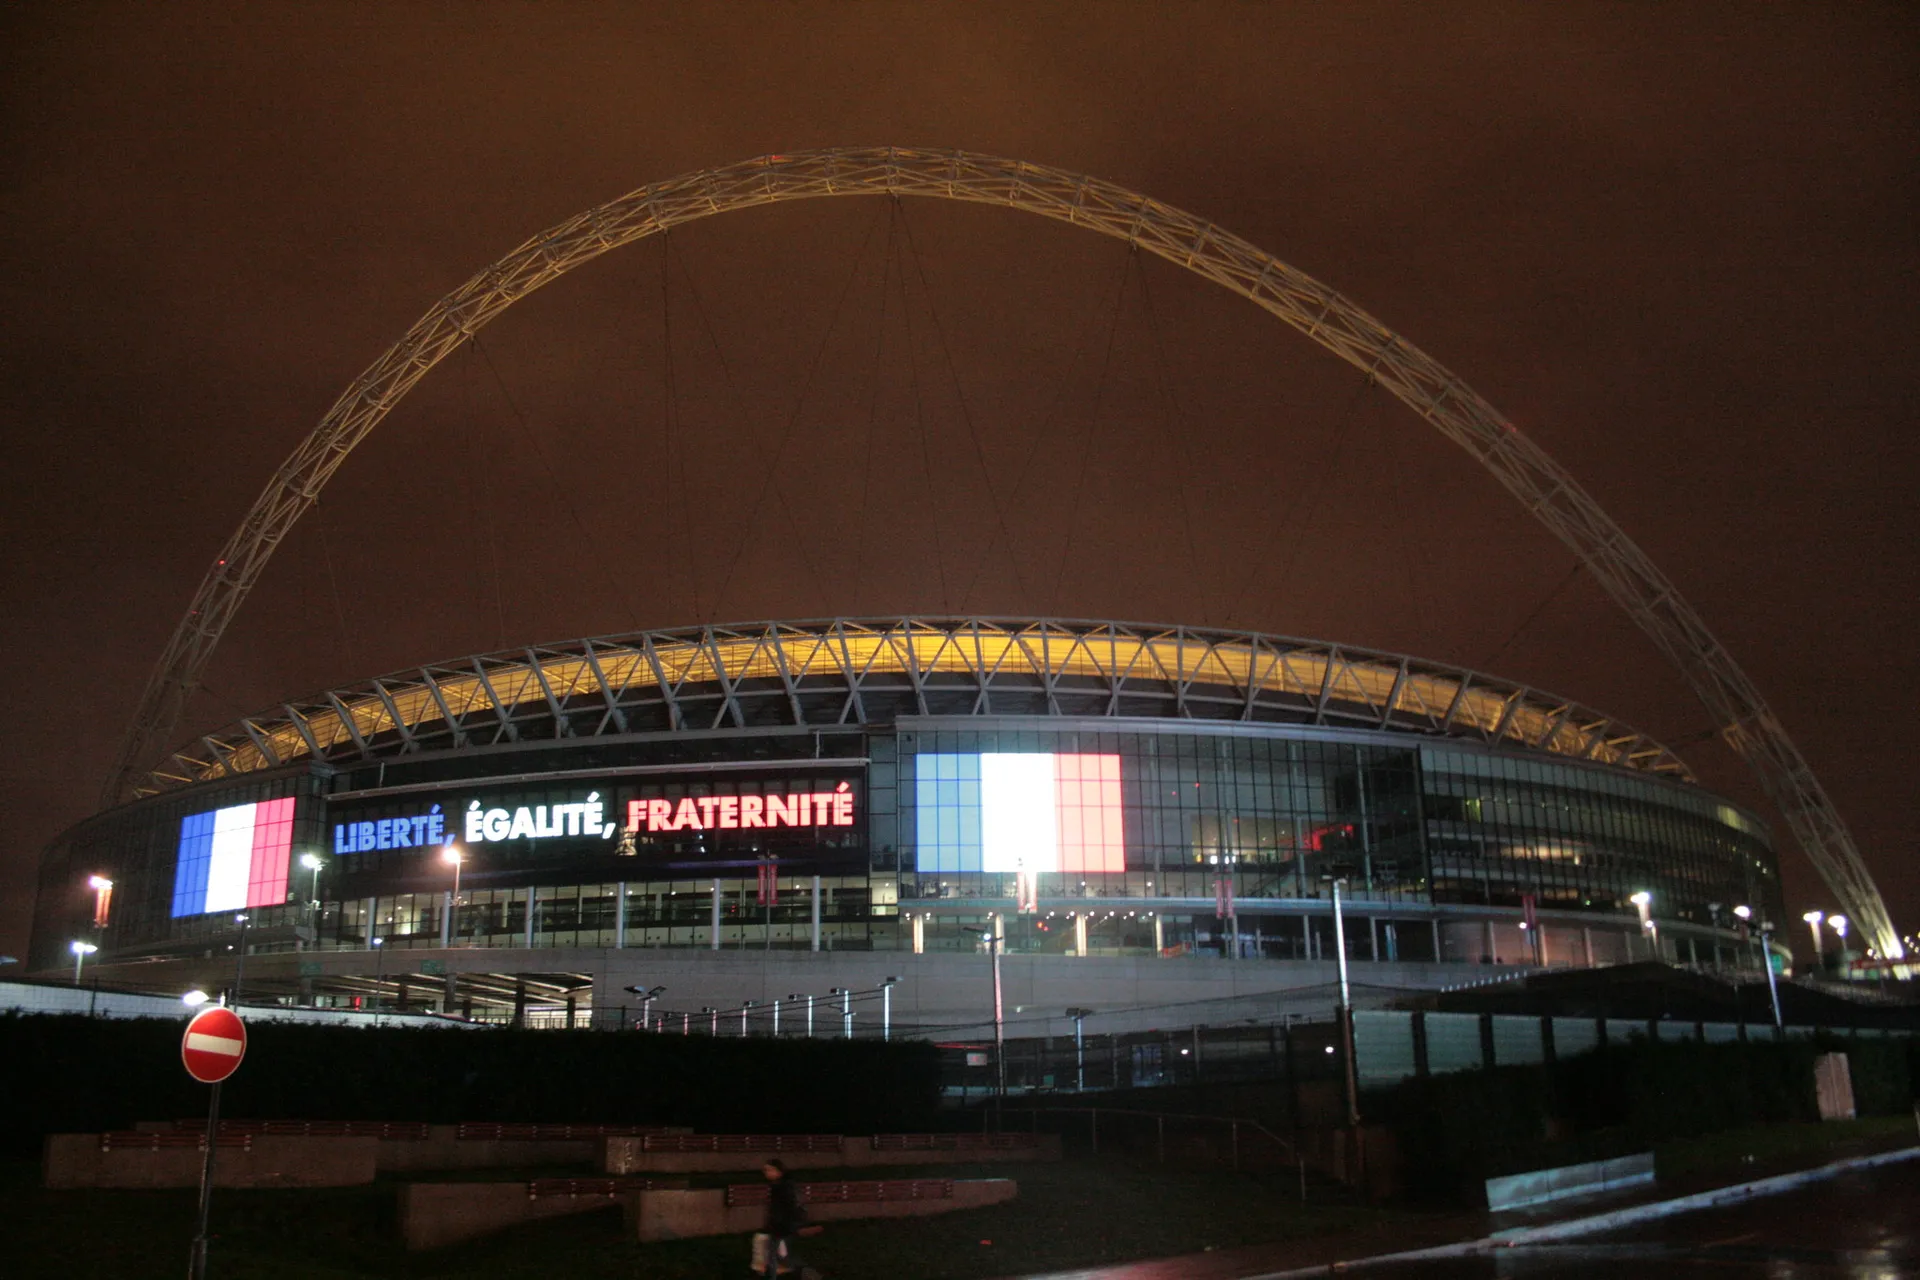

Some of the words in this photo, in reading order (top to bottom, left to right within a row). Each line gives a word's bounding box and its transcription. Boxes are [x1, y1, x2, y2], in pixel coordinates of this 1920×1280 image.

[335, 803, 456, 854] LIBERTÉ,
[465, 791, 616, 842] ÉGALITÉ,
[628, 781, 853, 832] FRATERNITÉ
